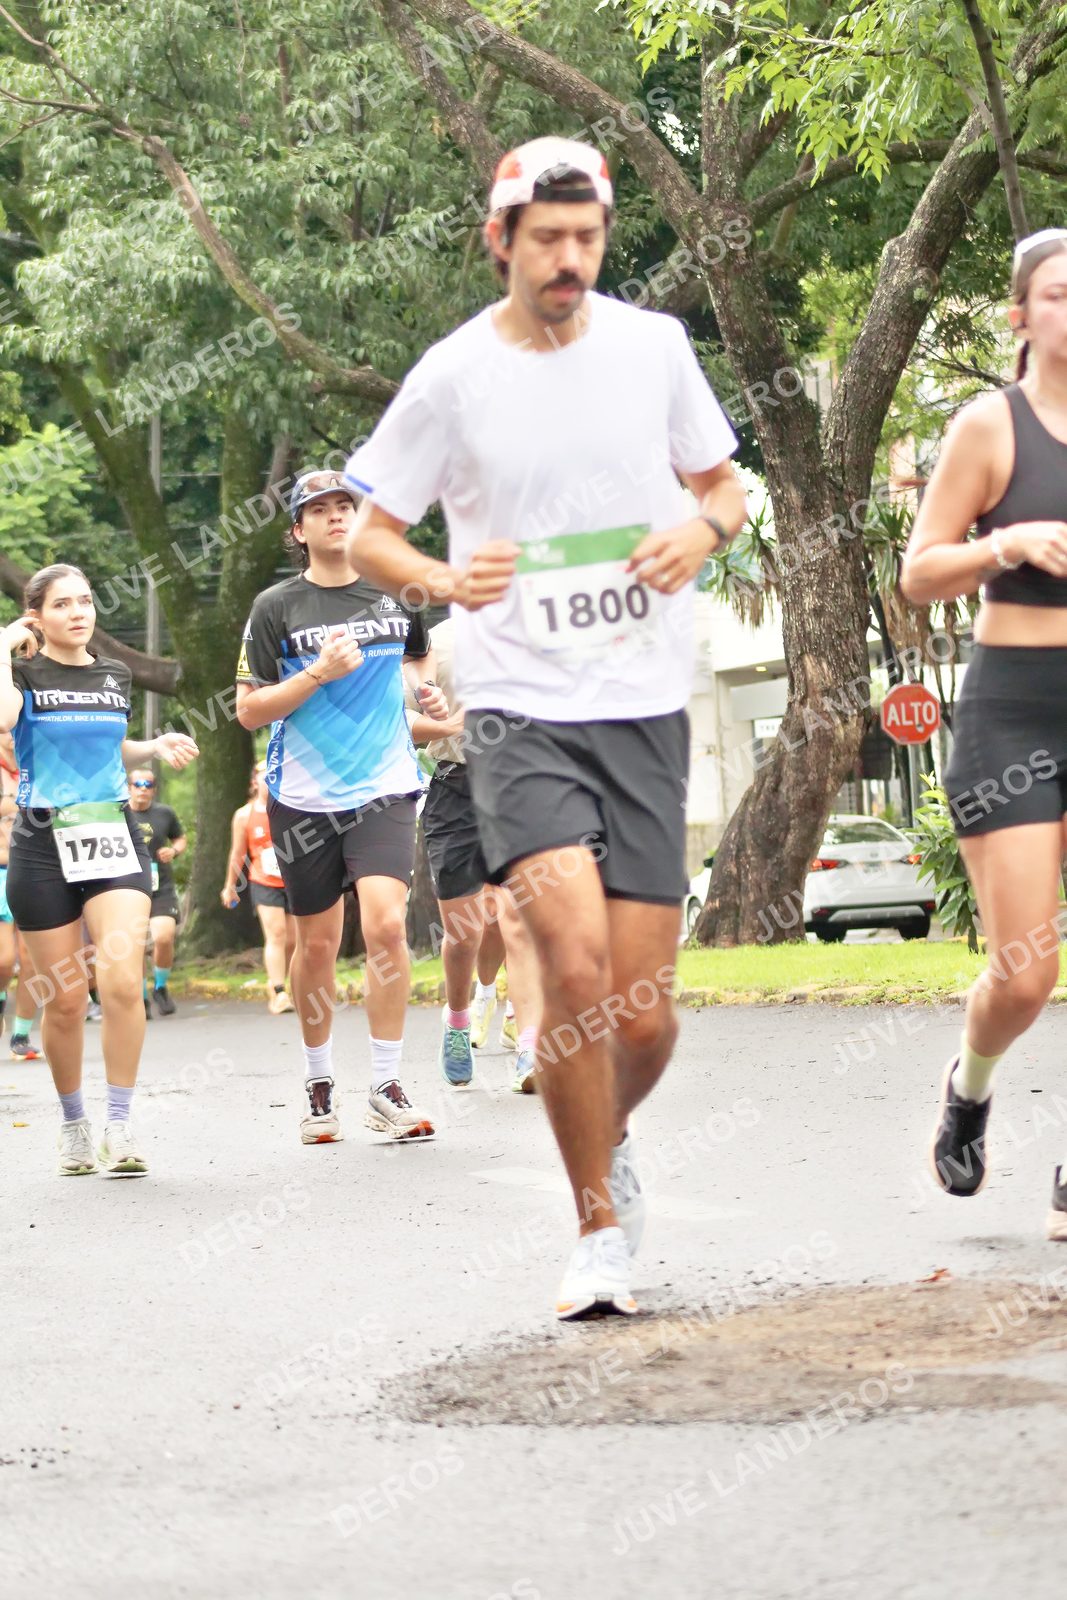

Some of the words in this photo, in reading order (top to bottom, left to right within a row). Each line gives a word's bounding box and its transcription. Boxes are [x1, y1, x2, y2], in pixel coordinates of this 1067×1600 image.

[538, 583, 649, 633] 1800
[886, 701, 937, 727] ALTO
[65, 837, 129, 863] 1783
